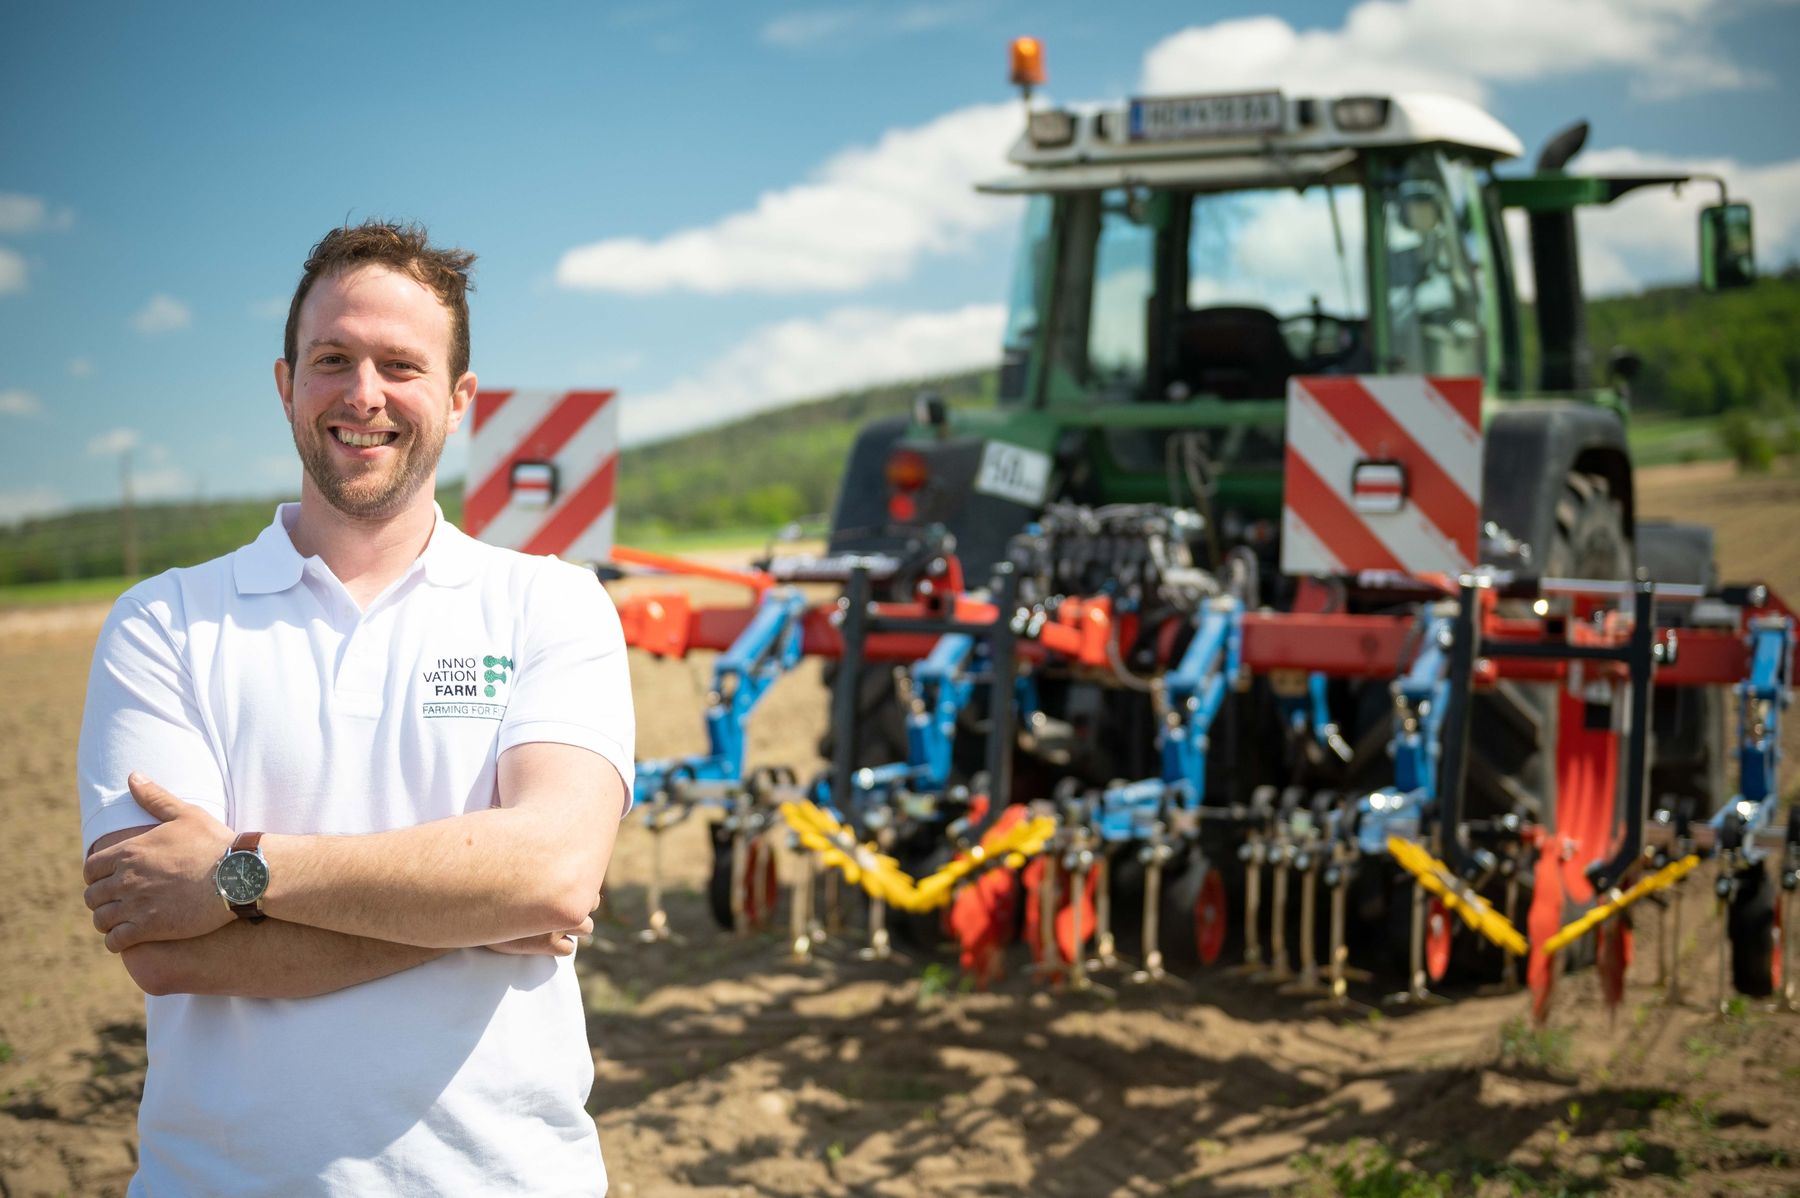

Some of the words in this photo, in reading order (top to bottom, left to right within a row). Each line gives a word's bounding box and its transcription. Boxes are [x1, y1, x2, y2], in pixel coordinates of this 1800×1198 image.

[437, 657, 476, 669] INNO
[423, 670, 476, 682] VATION
[435, 685, 477, 696] FARM
[422, 705, 469, 715] FARMING
[471, 705, 491, 715] FOR
